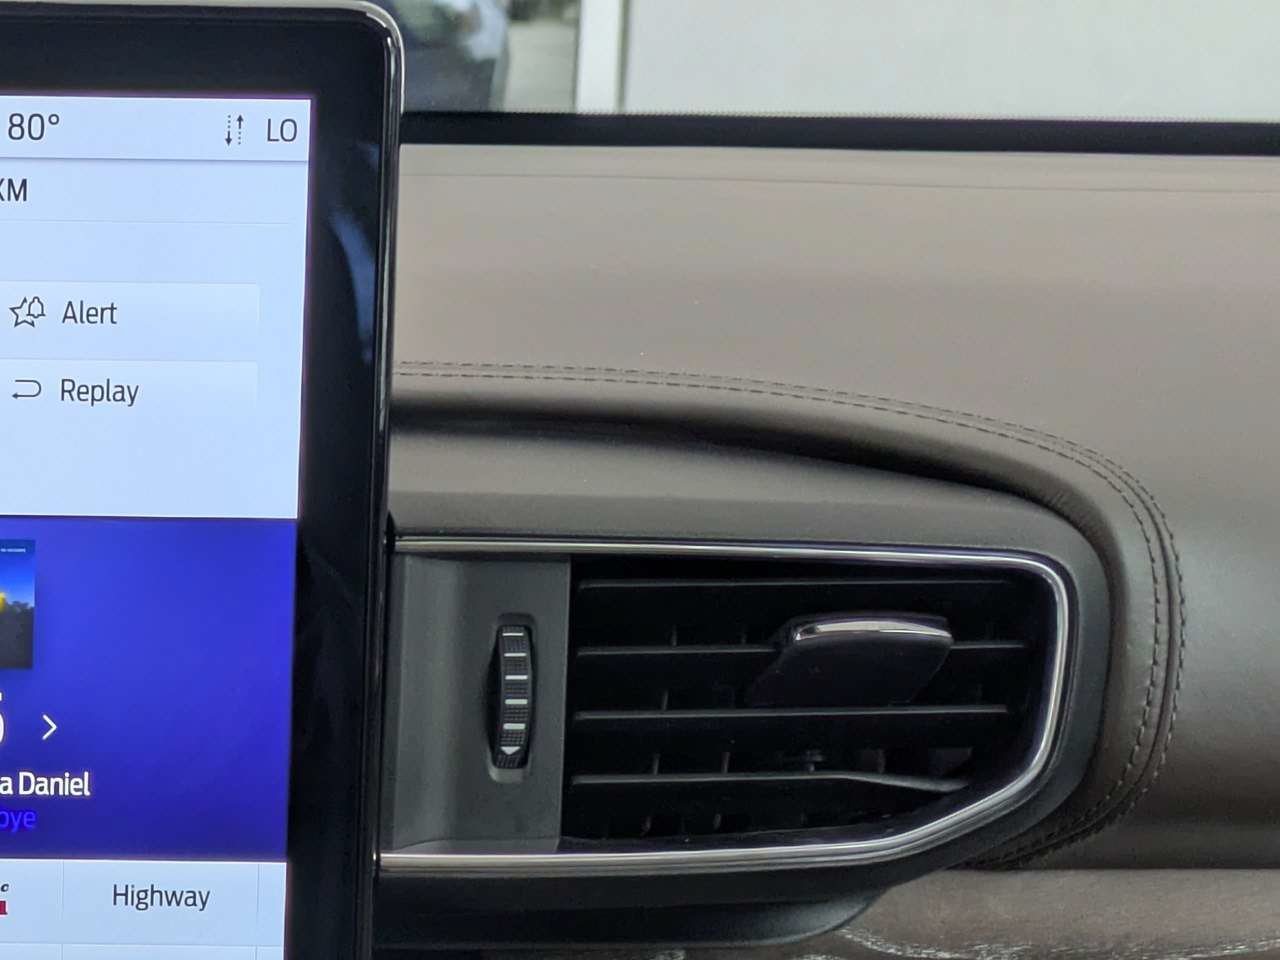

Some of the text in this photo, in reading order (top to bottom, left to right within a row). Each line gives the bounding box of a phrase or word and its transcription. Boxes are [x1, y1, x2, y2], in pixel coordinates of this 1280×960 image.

[8, 113, 59, 140] 80°
[267, 119, 297, 142] LO
[62, 300, 117, 324] Alert
[61, 379, 139, 407] Replay
[19, 772, 90, 796] Daniel
[114, 884, 210, 911] Highway
